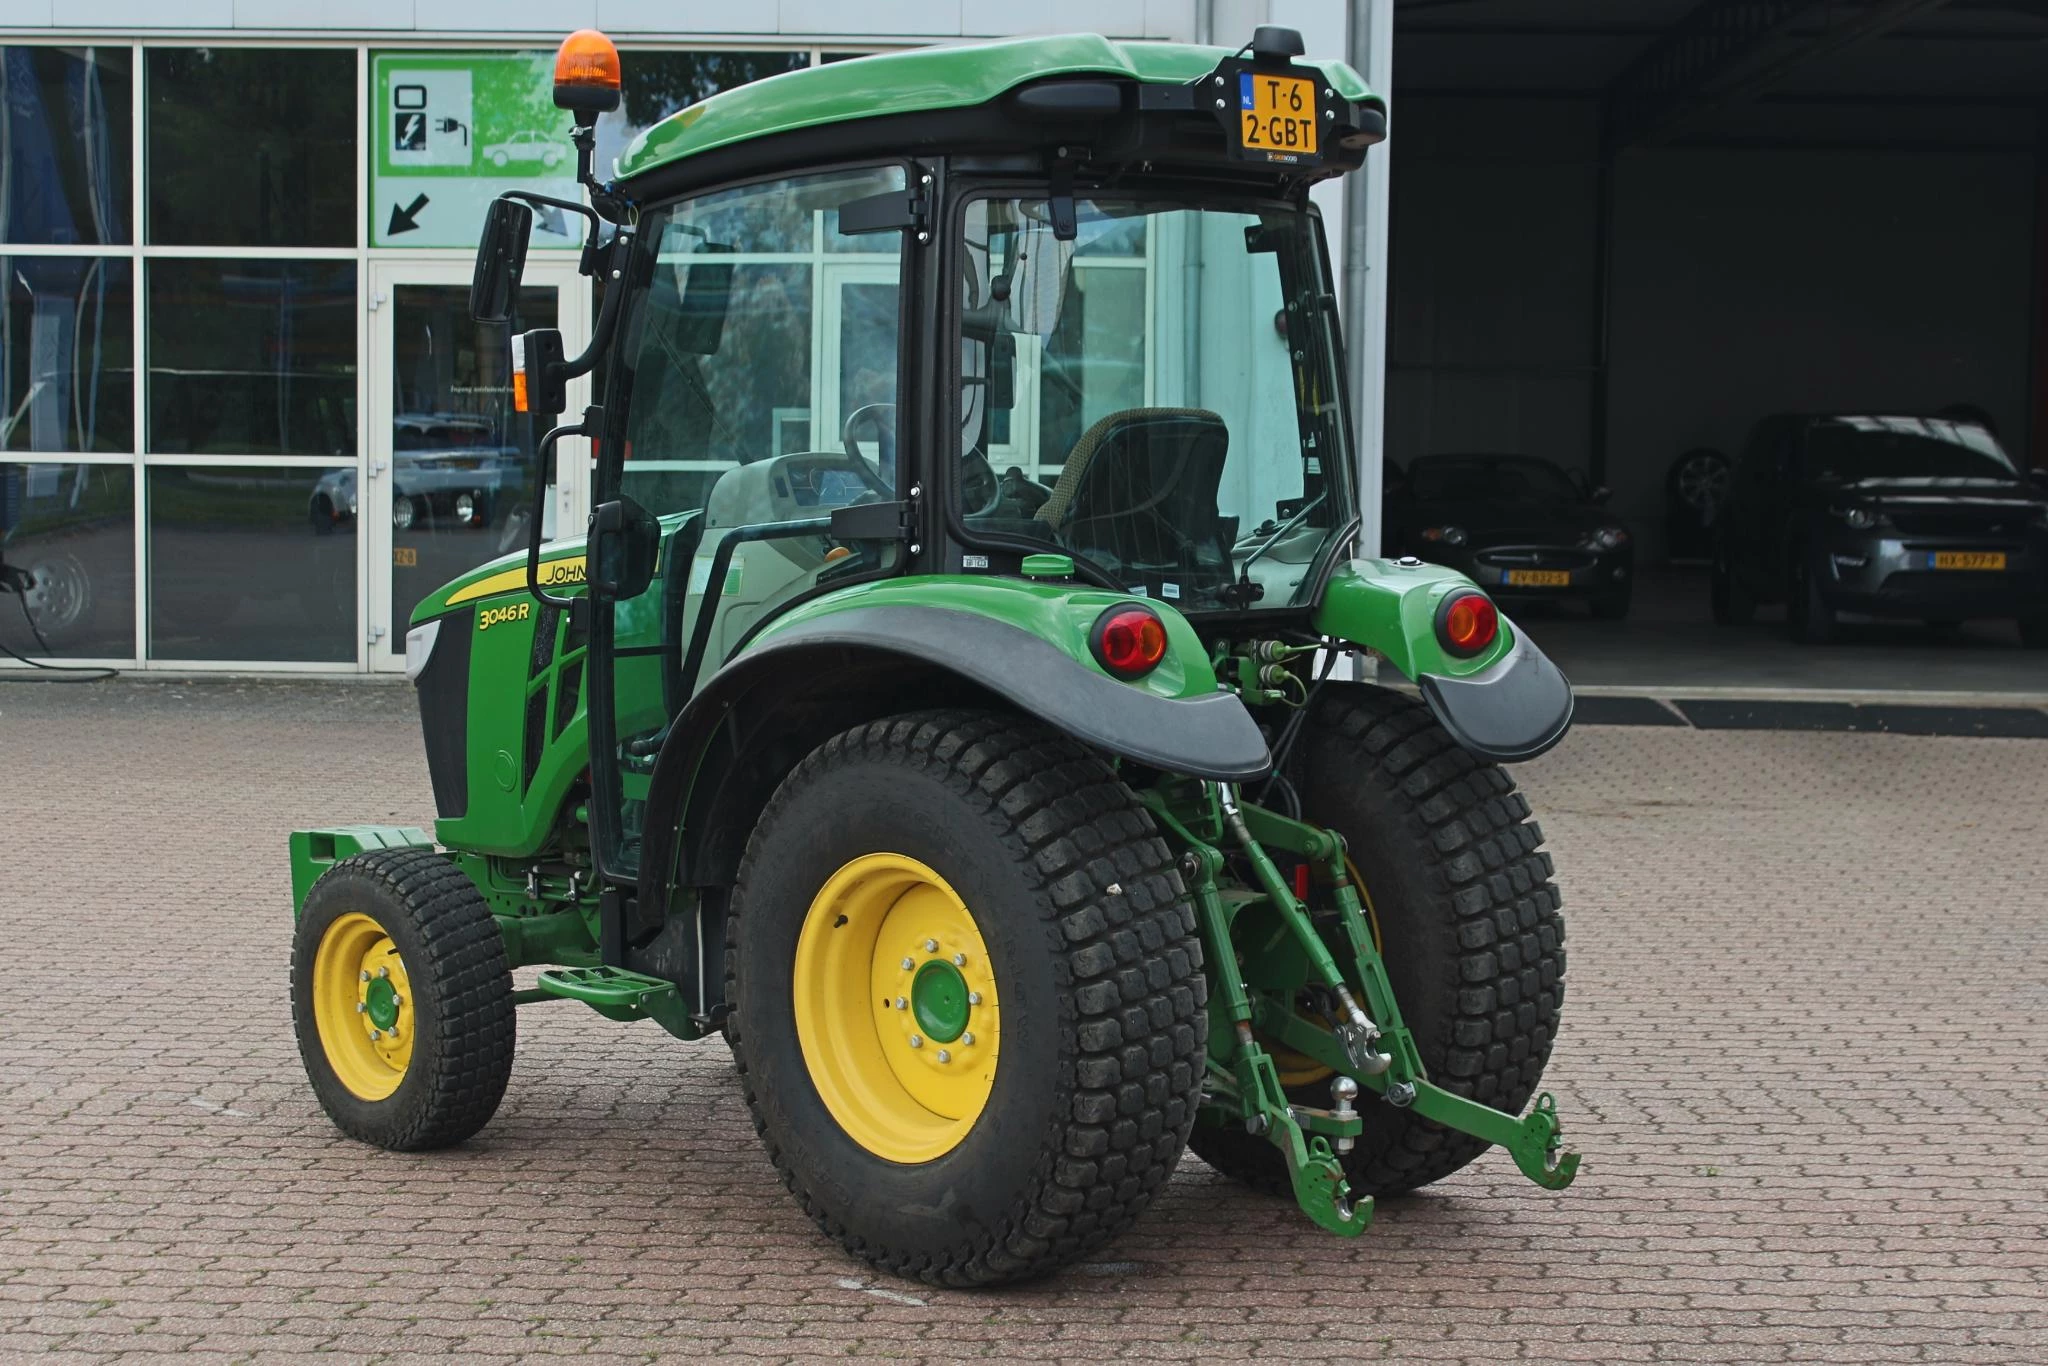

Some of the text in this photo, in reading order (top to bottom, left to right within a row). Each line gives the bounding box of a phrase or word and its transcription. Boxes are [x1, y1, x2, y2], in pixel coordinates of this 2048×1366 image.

[1242, 95, 1252, 105] NL
[1267, 80, 1303, 112] T-6
[1246, 114, 1312, 148] 2-GBT
[546, 564, 587, 583] JOHN
